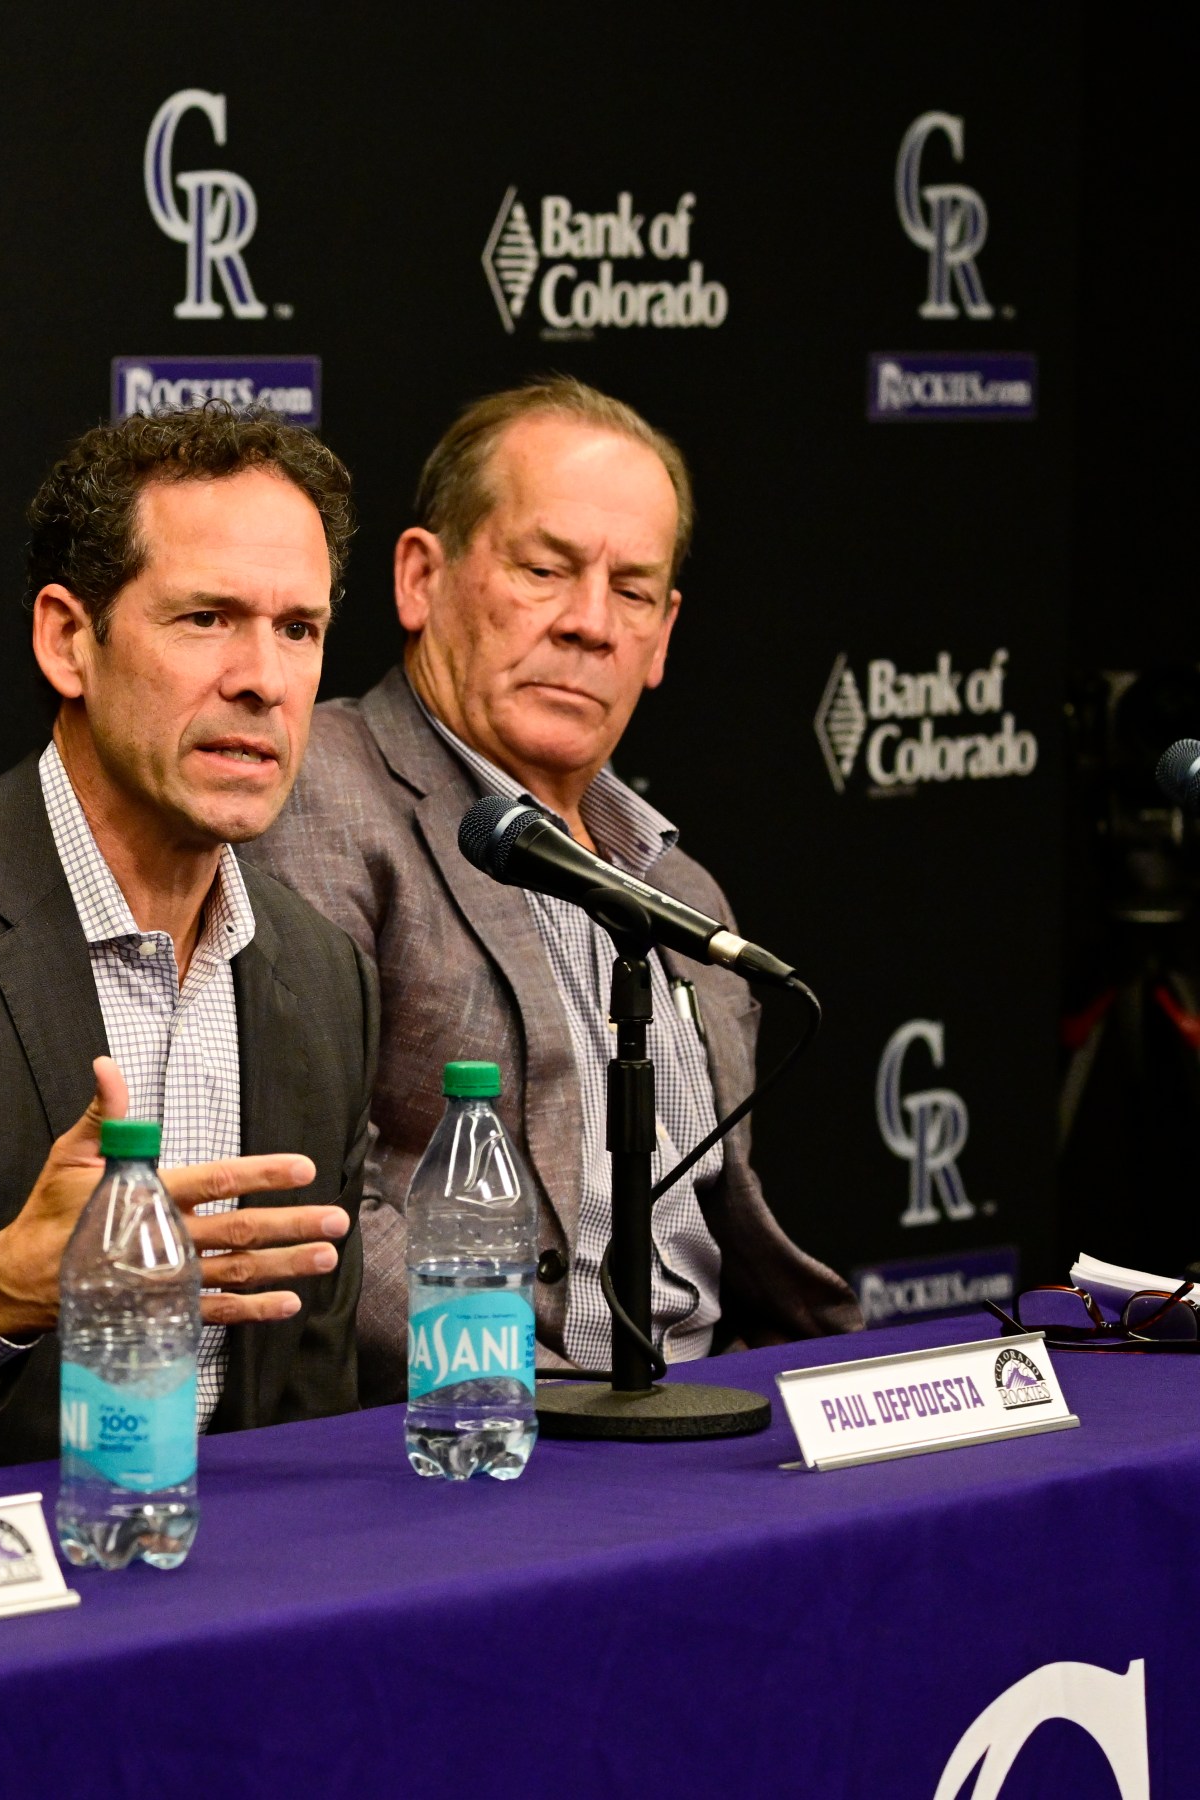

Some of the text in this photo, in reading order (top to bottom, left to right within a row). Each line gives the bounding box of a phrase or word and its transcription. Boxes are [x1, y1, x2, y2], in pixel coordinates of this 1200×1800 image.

[541, 192, 696, 260] Bank of
[539, 261, 728, 328] Colorado
[868, 648, 1009, 719] Bank of
[866, 713, 1037, 786] Colorado
[996, 1350, 1040, 1382] COLORADO
[998, 1382, 1051, 1406] ROCKIES
[821, 1376, 985, 1433] PAUL DEPODESTA
